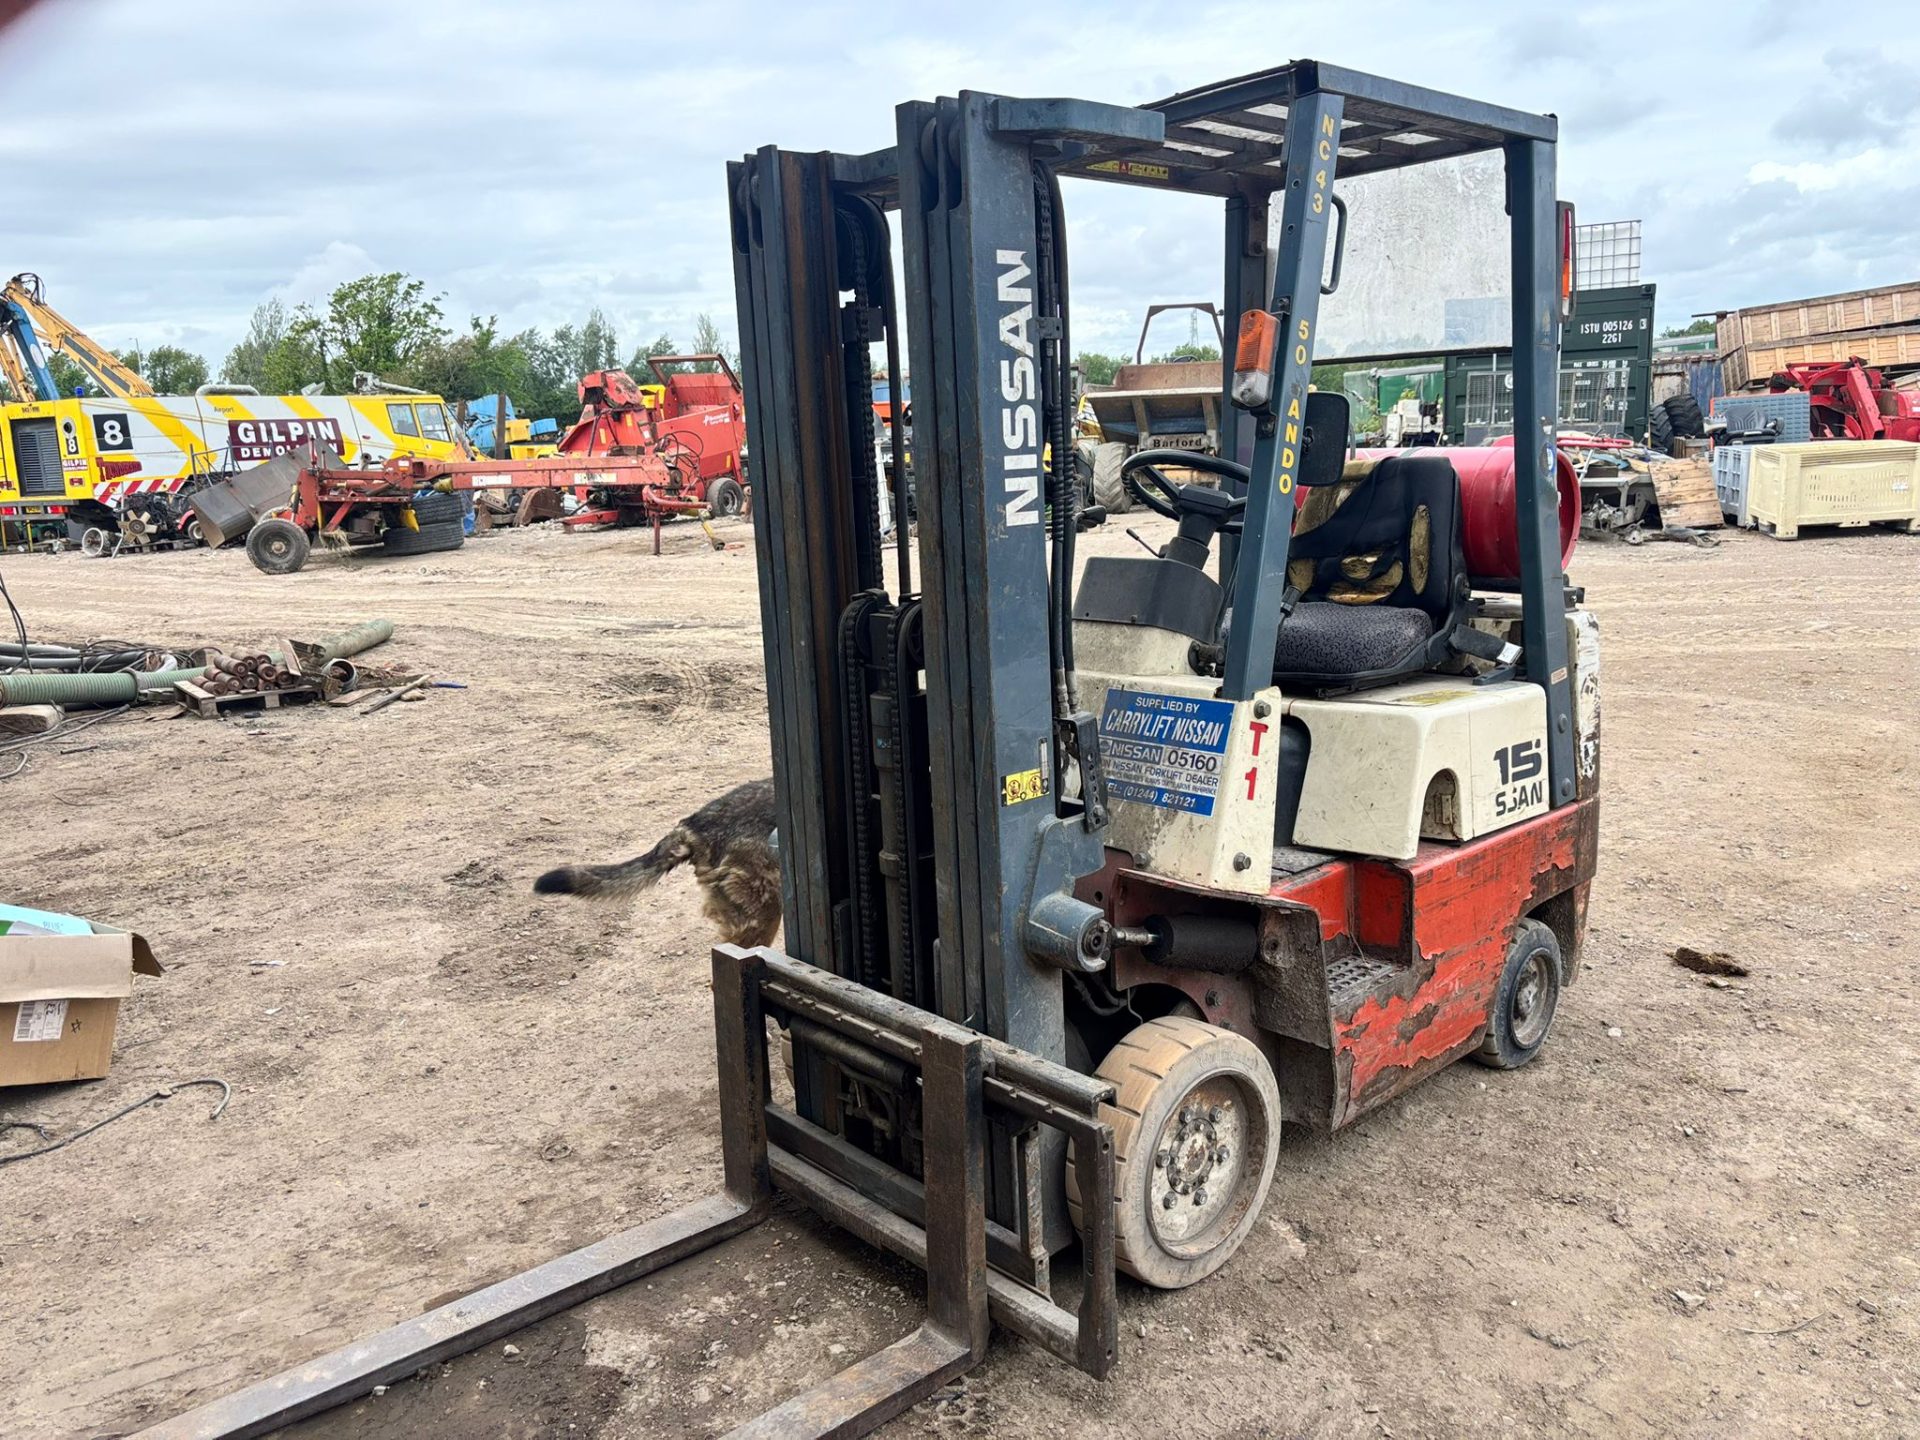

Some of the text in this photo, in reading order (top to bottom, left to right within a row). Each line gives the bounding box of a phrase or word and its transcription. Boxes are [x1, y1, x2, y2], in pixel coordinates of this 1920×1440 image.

[1602, 320, 1633, 332] 005126
[996, 249, 1039, 526] NISSAN
[103, 420, 124, 446] 8
[237, 421, 337, 444] GILPIN
[1153, 438, 1202, 448] Barford
[67, 438, 77, 453] 8
[1185, 702, 1200, 713] BY
[1105, 708, 1224, 746] CARRYLIFT NISSAN
[1111, 741, 1162, 762] NISSAN
[1167, 750, 1217, 772] 05160
[1112, 760, 1142, 774] NISSAN
[1145, 766, 1184, 780] FORKLIFT
[1185, 773, 1218, 787] DEALER
[1106, 781, 1196, 807] EL: (01244) 821121
